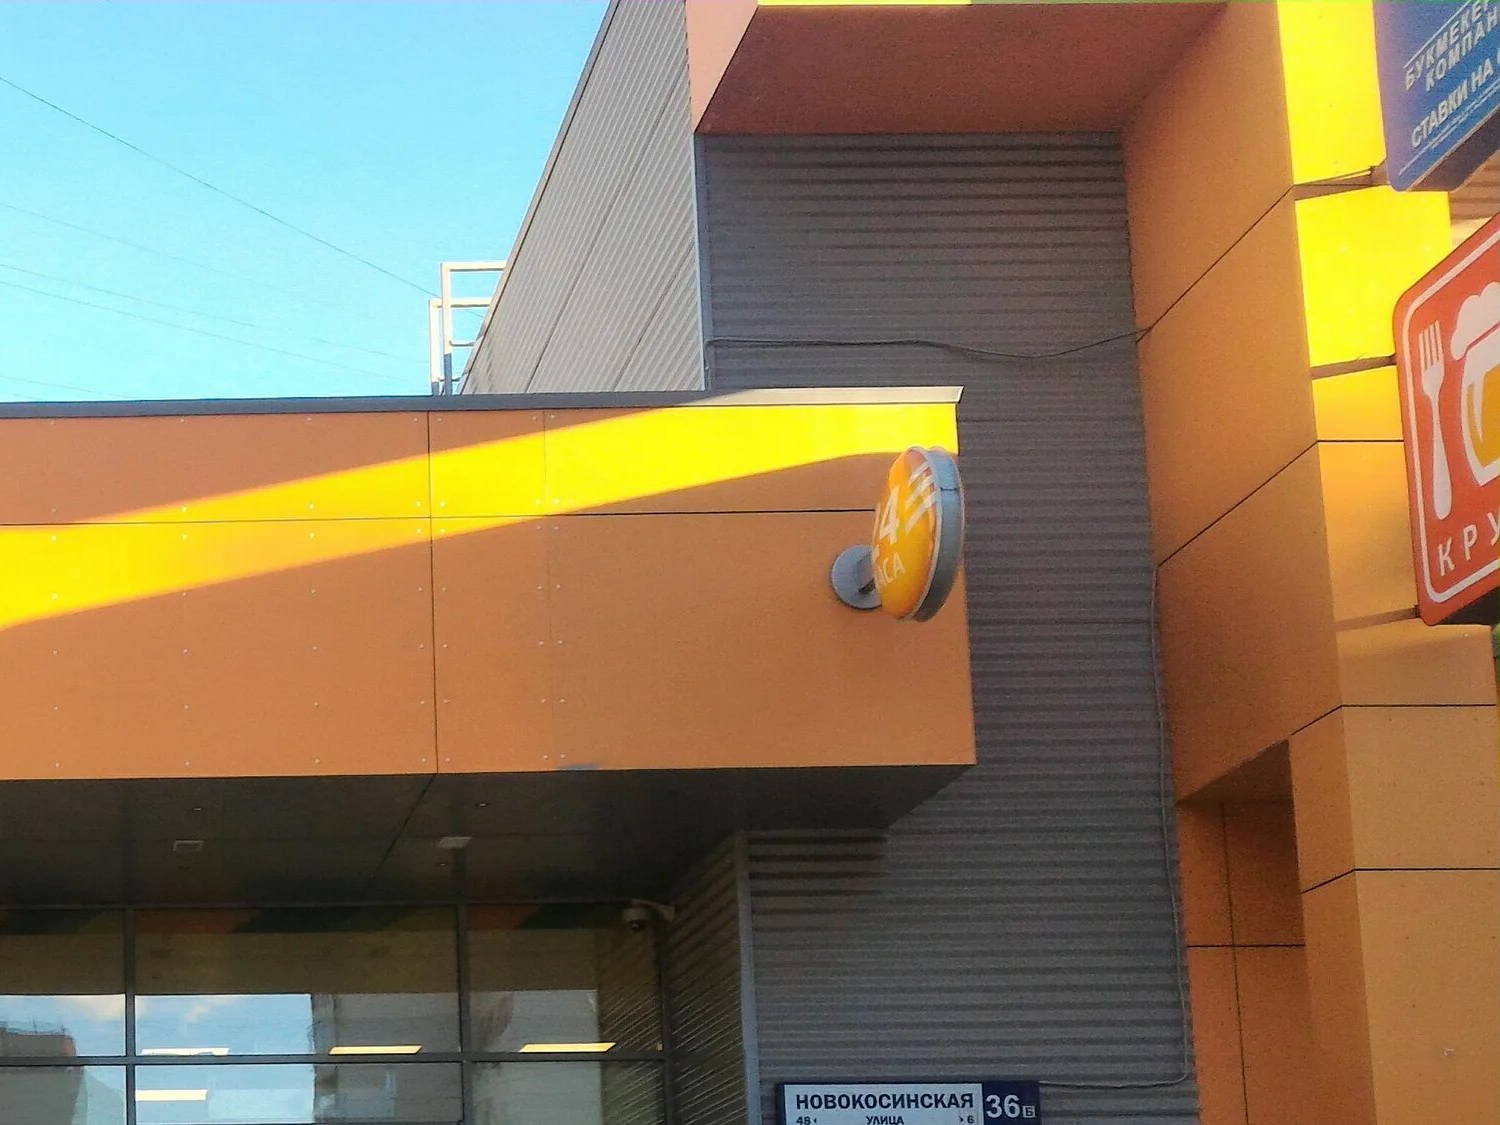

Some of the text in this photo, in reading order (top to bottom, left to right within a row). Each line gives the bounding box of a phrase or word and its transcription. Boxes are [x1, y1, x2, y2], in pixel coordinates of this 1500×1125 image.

[1411, 79, 1468, 149] СТАВКИ
[1471, 58, 1494, 92] НА
[795, 1092, 974, 1109] НОВОКОСИНСКАЯ
[796, 1115, 811, 1125] 48
